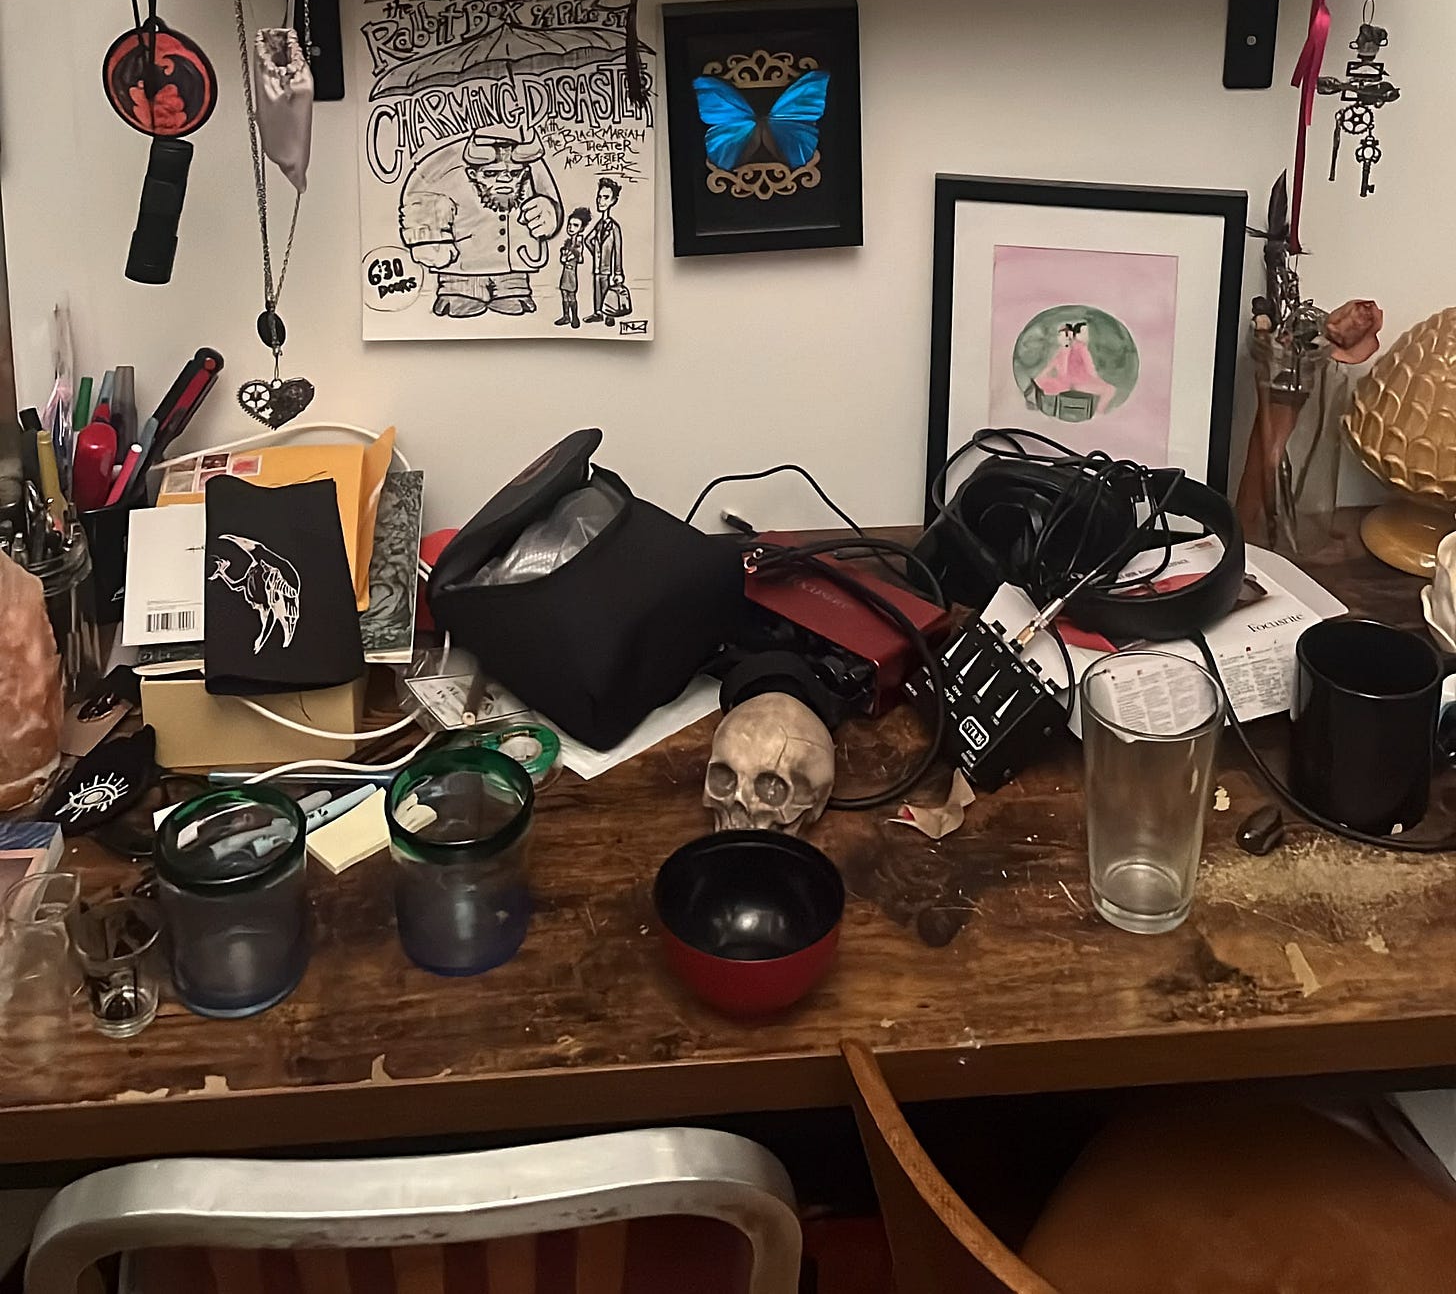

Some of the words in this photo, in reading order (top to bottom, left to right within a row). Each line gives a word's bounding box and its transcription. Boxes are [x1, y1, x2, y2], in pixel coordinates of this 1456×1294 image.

[360, 1, 464, 77] Rabbit
[531, 4, 555, 27] 94
[557, 1, 600, 26] Pike
[521, 63, 655, 129] DISASTER
[564, 154, 583, 170] AND
[601, 162, 641, 173] INK
[368, 258, 404, 286] 6:30
[378, 277, 418, 299] DOORS
